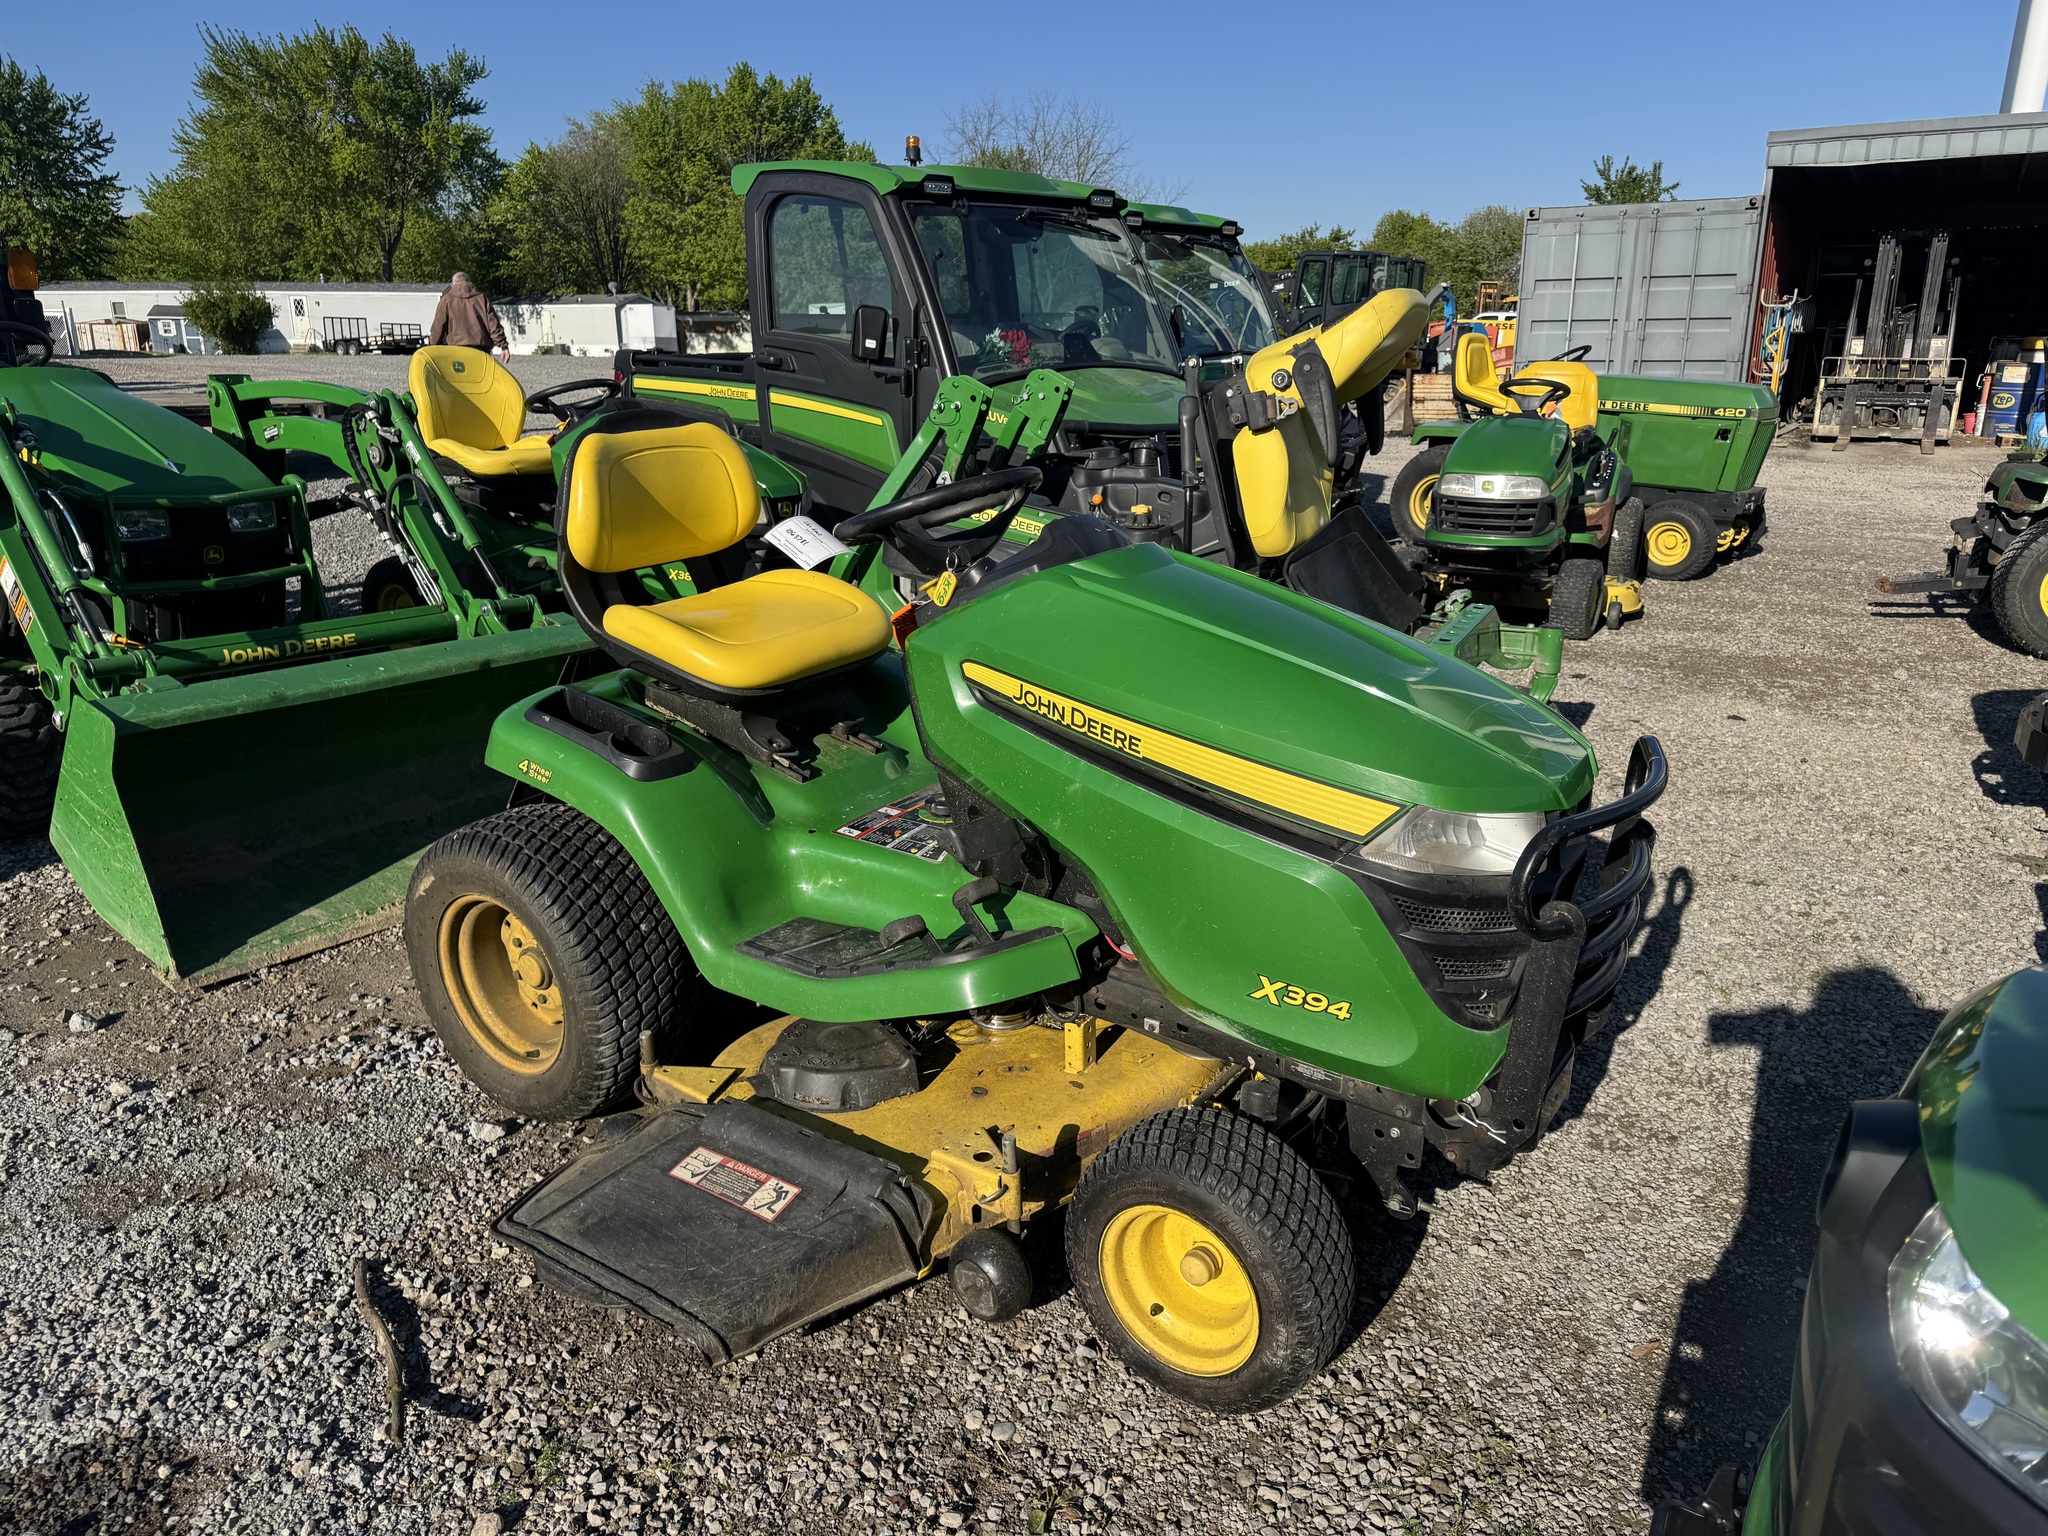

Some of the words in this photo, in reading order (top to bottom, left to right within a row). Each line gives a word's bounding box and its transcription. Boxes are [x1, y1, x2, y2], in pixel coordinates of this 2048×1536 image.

[709, 386, 726, 397] JOHN
[727, 388, 749, 399] DEERE
[1611, 401, 1650, 411] DEERE
[1714, 408, 1746, 418] 420
[1009, 517, 1042, 535] DEER
[218, 644, 280, 667] JOHN
[284, 633, 358, 656] DEERE
[1013, 683, 1066, 723] JOHN
[1071, 706, 1142, 755] DEERE
[518, 759, 529, 774] 4
[530, 761, 553, 778] Wheel
[529, 769, 550, 785] Steer
[1247, 973, 1353, 1021] X394
[734, 1163, 767, 1180] DANGER
